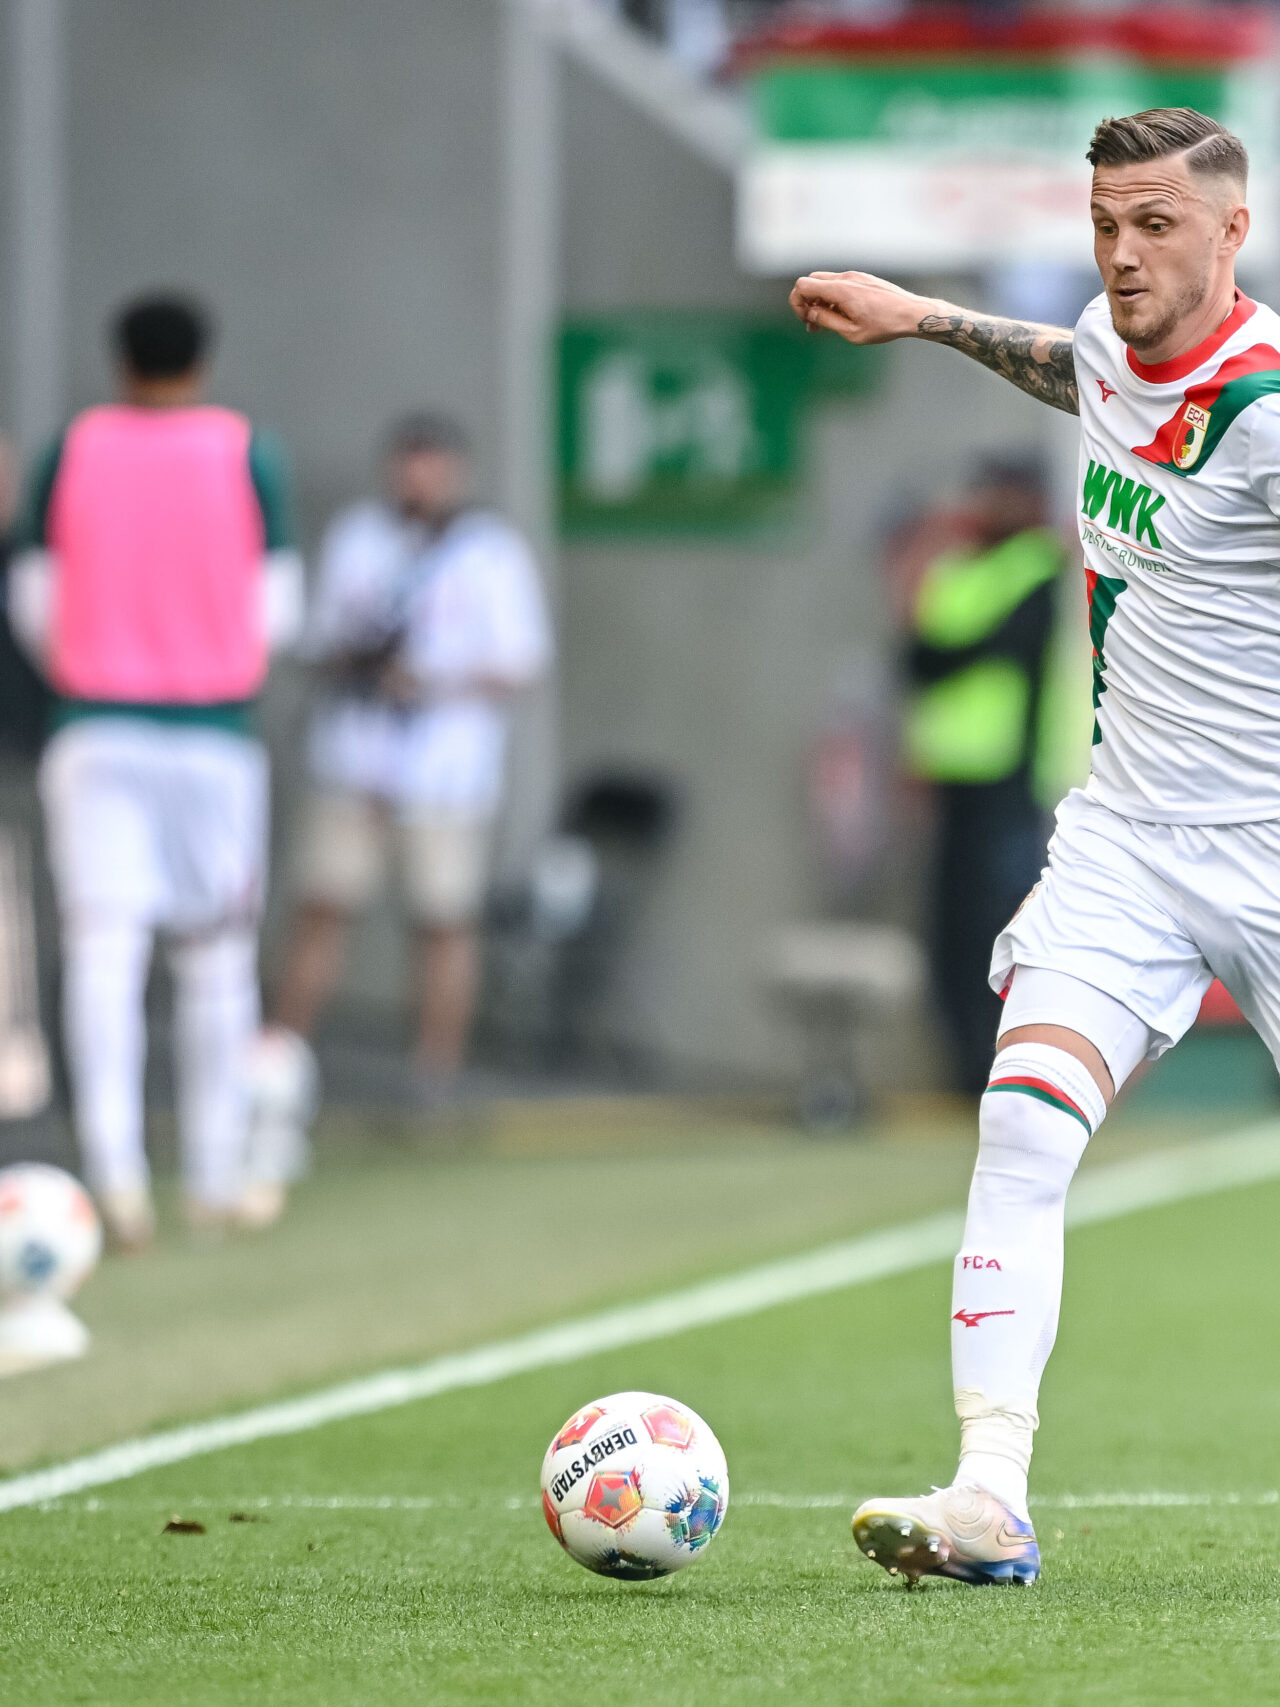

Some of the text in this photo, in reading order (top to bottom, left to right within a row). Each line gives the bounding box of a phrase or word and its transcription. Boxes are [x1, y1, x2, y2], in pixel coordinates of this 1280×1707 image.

[1081, 459, 1166, 550] WWK
[963, 1255, 1002, 1272] FCA
[552, 1428, 638, 1503] DERBYSTAR
